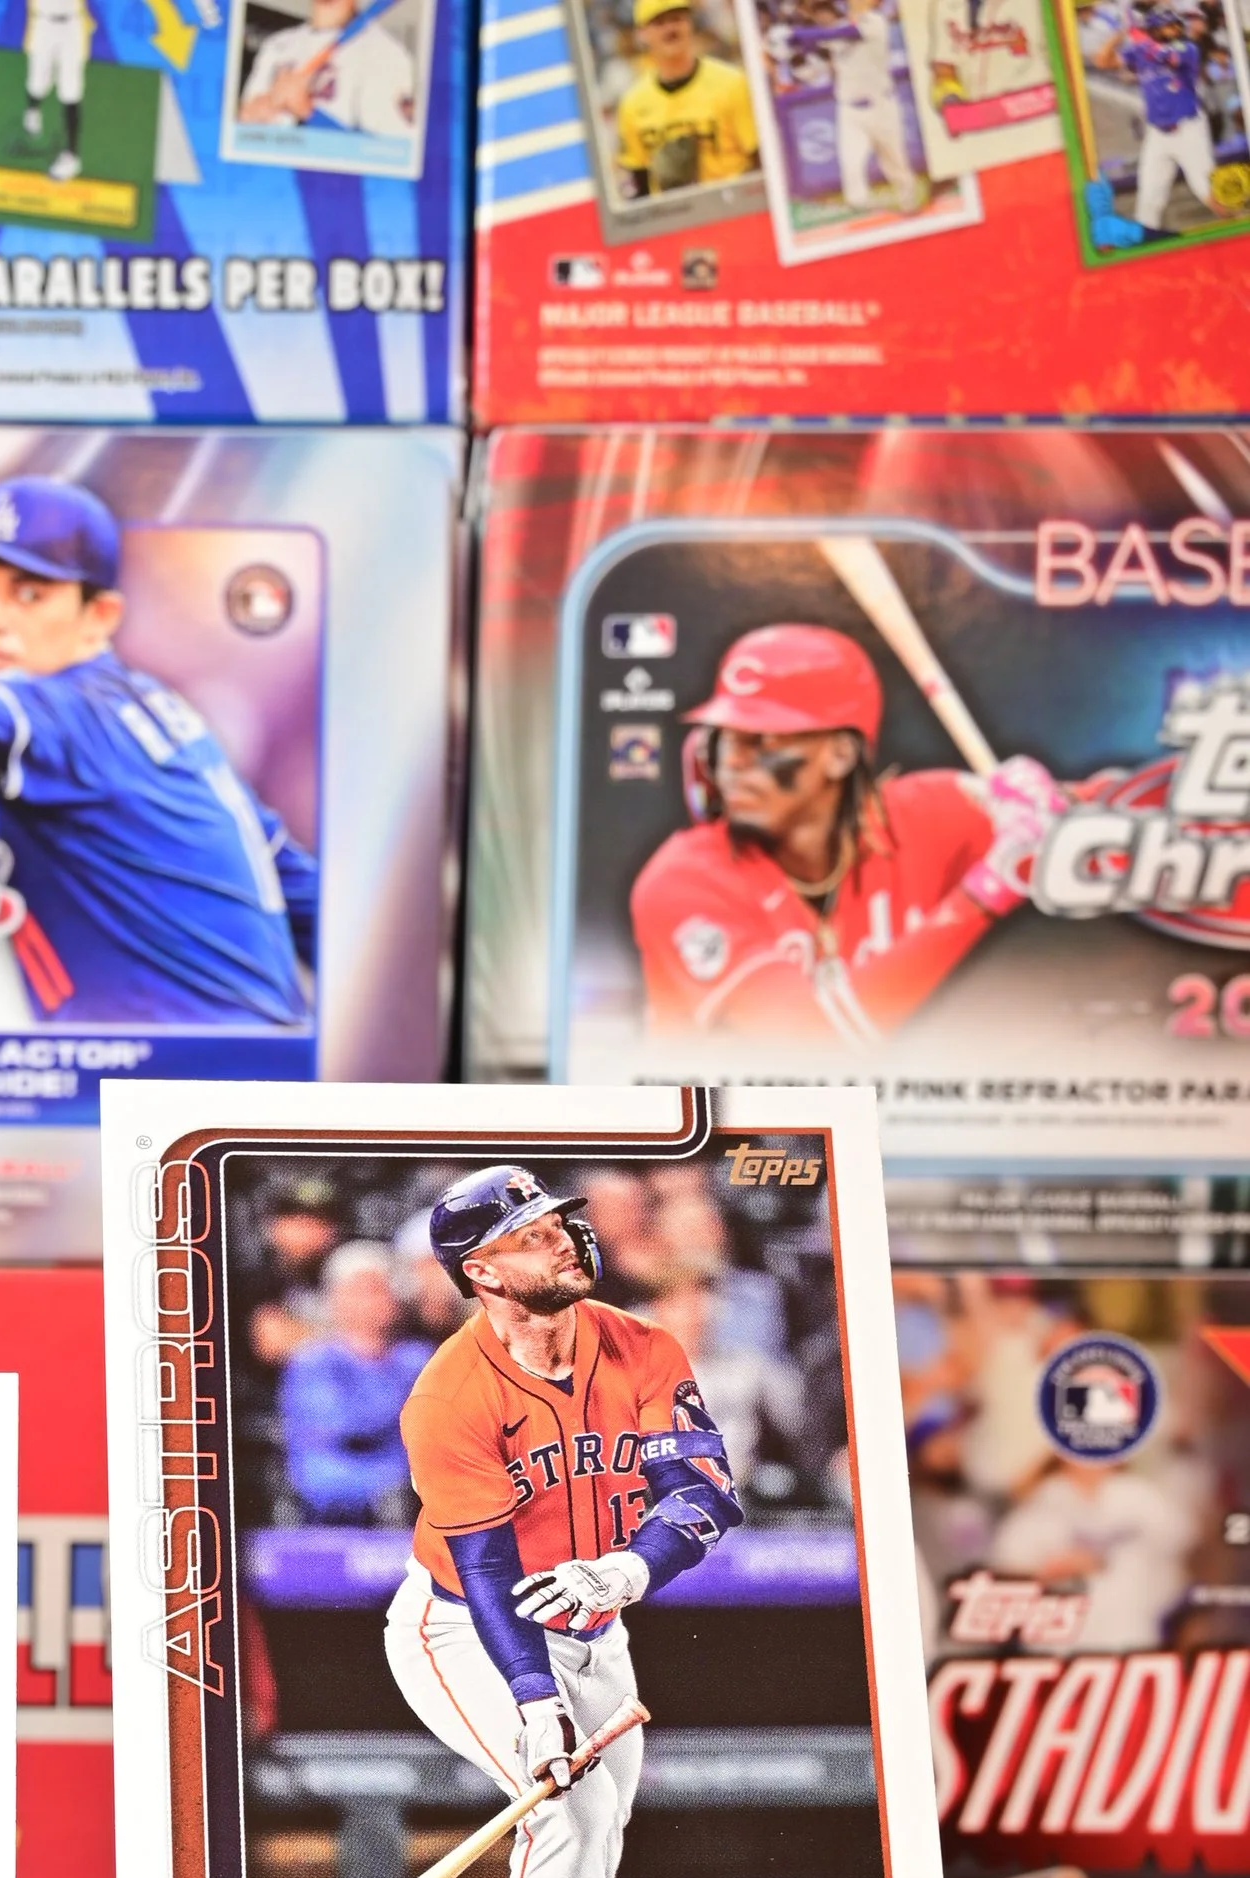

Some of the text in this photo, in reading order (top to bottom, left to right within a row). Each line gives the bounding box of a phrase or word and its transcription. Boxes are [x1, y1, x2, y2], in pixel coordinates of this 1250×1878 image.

[223, 258, 318, 312] PER
[327, 260, 446, 313] BOX!
[539, 301, 629, 327] MAJOR
[634, 301, 731, 327] LEAGUE
[895, 1077, 965, 1105] PINK
[980, 1077, 1171, 1106] REFRACTOR
[725, 1143, 823, 1186] Topps
[131, 1159, 225, 1698] ASTROS
[507, 1431, 646, 1509] STRO
